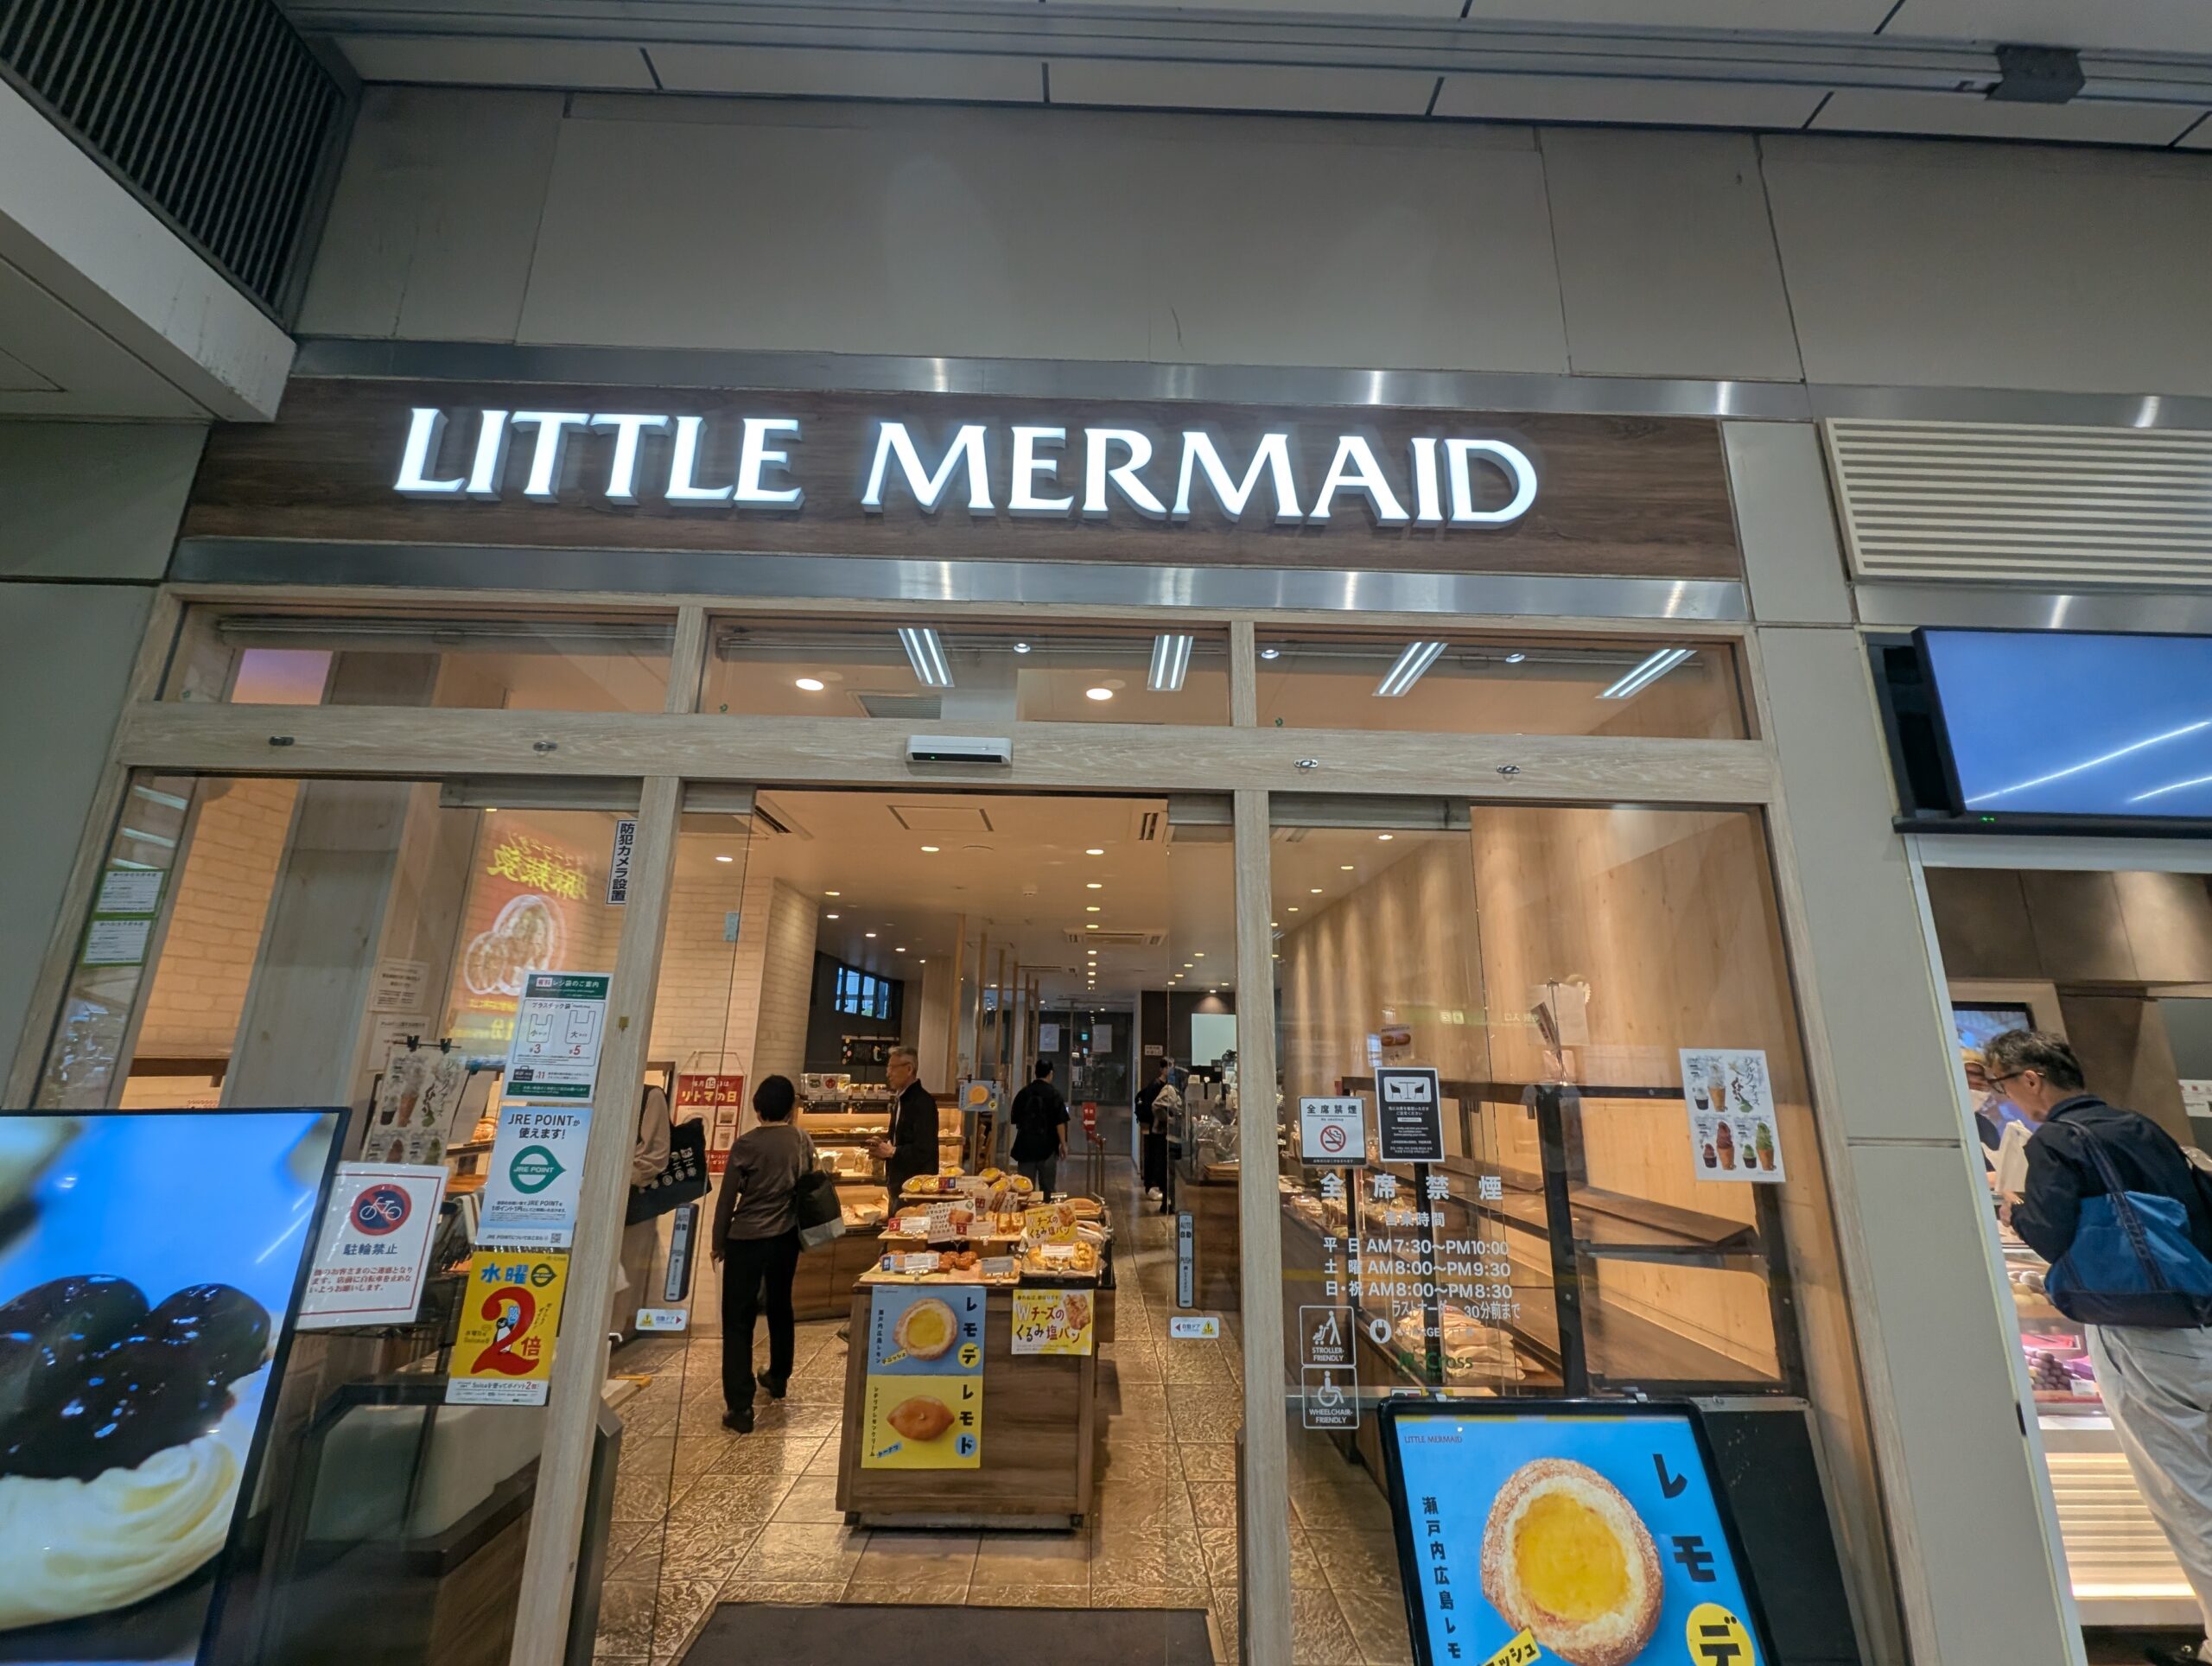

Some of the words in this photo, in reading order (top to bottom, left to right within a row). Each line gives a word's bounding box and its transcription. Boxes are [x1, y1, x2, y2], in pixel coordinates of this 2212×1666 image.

[393, 408, 804, 509] LITTLE
[861, 422, 1539, 526] MERMAID
[611, 823, 635, 901] 防犯カメラ設置
[1306, 1104, 1357, 1115] 全席禁煙
[508, 1114, 531, 1125] JRE
[1319, 1173, 1503, 1200] 全席禁煙
[1385, 1211, 1446, 1228] 営業時間
[343, 1243, 398, 1256] 駐輪禁止
[1323, 1237, 1360, 1253] 平日
[480, 1262, 529, 1284] 水曜
[1325, 1259, 1363, 1275] 土曜
[1464, 1301, 1521, 1319] 30分前まで
[470, 1286, 540, 1376] 2
[962, 1297, 979, 1364] レモデ
[1016, 1324, 1080, 1343] くるみ塩パン
[521, 1337, 542, 1357] 倍
[1313, 1354, 1344, 1363] FRIENDLY
[959, 1384, 974, 1454] レモド
